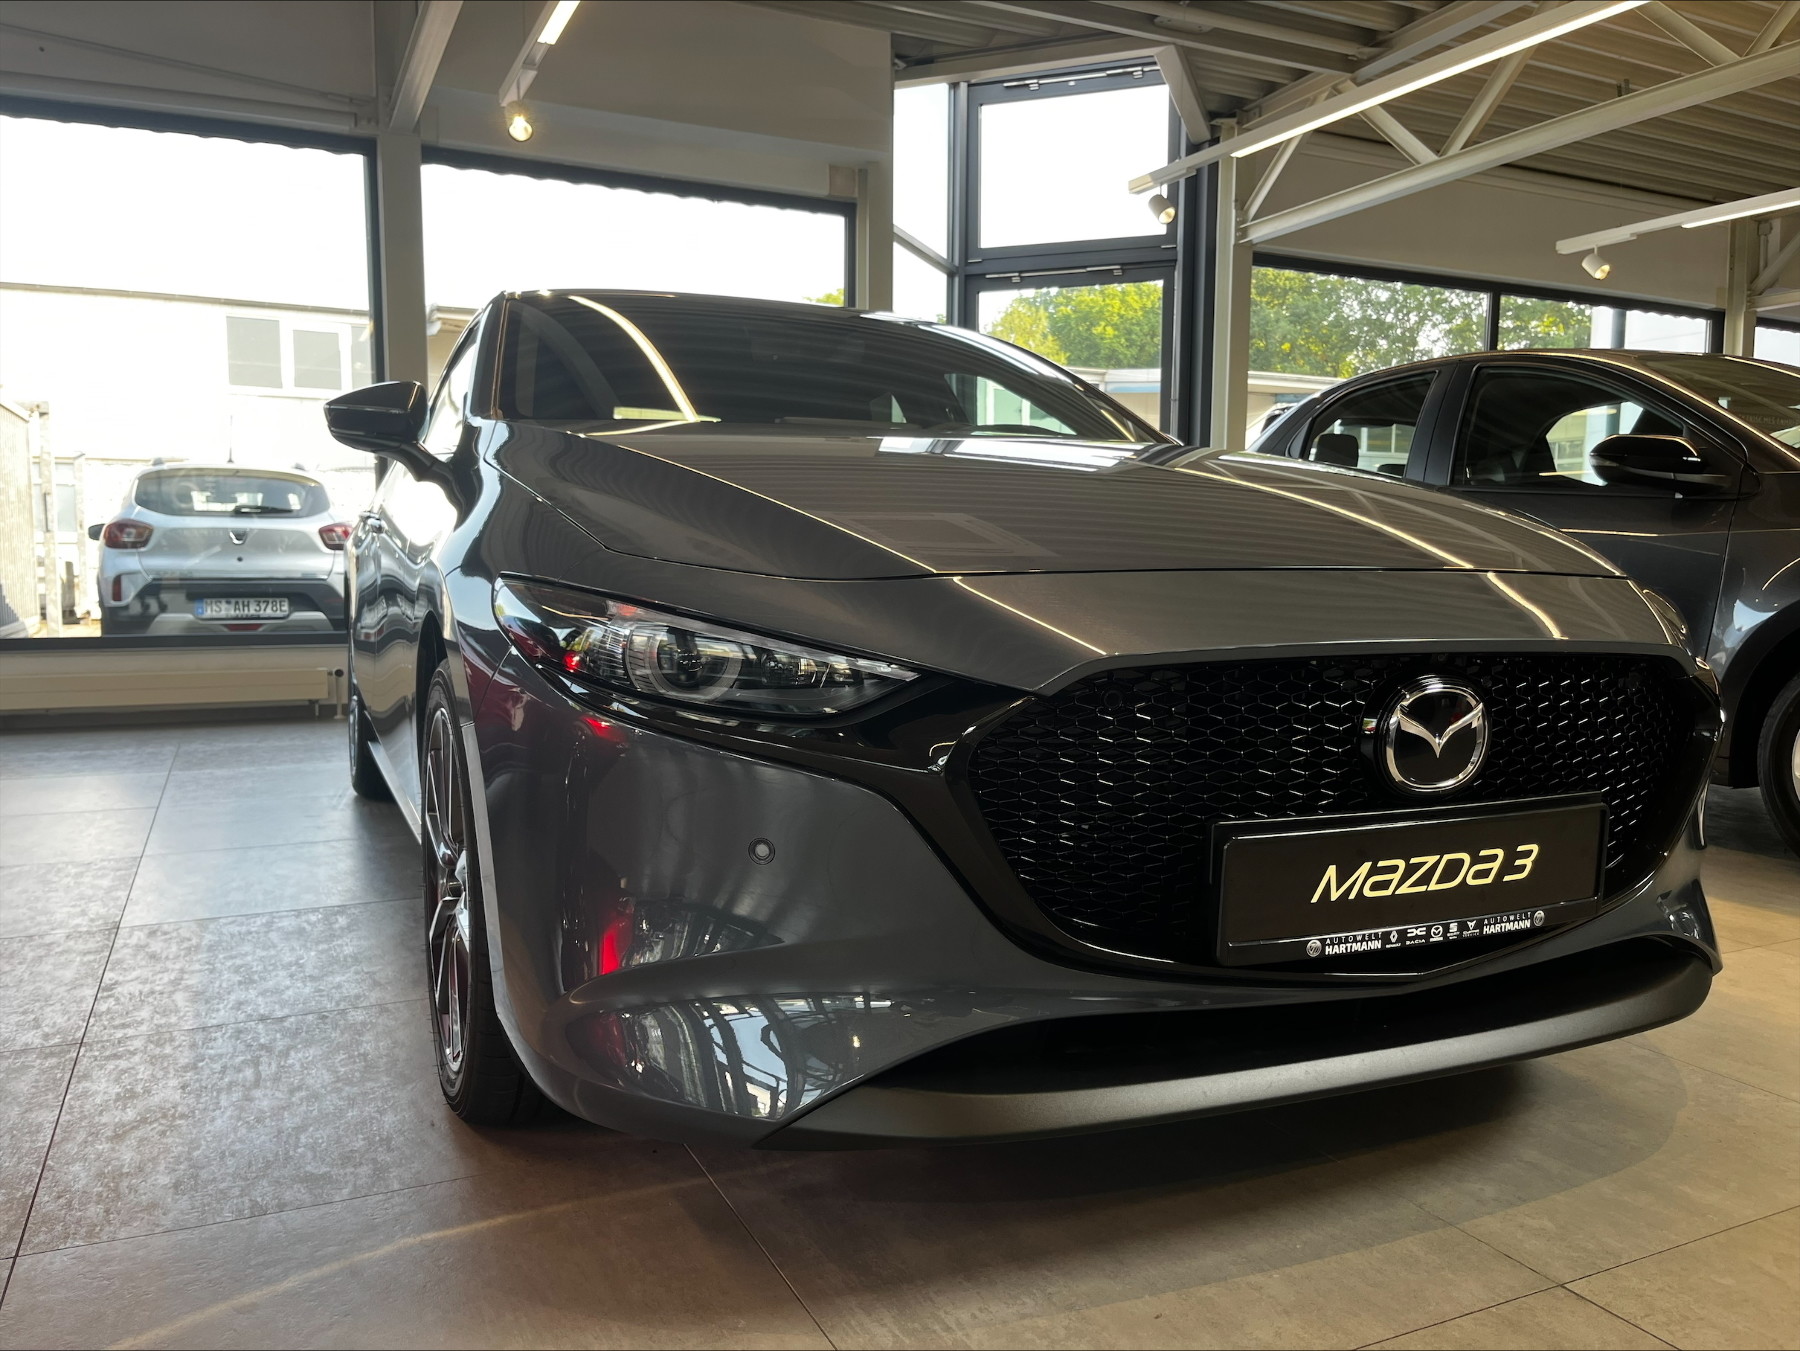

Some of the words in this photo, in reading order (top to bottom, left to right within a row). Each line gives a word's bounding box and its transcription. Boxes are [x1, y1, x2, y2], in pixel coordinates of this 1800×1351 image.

[205, 600, 222, 613] MS
[233, 600, 251, 613] AH
[254, 600, 288, 613] 378E
[1483, 911, 1531, 925] AUTOWELT
[1483, 919, 1531, 935] HARTMANN
[1325, 932, 1382, 944] AUTOWELT
[1325, 939, 1382, 955] HARTMANN
